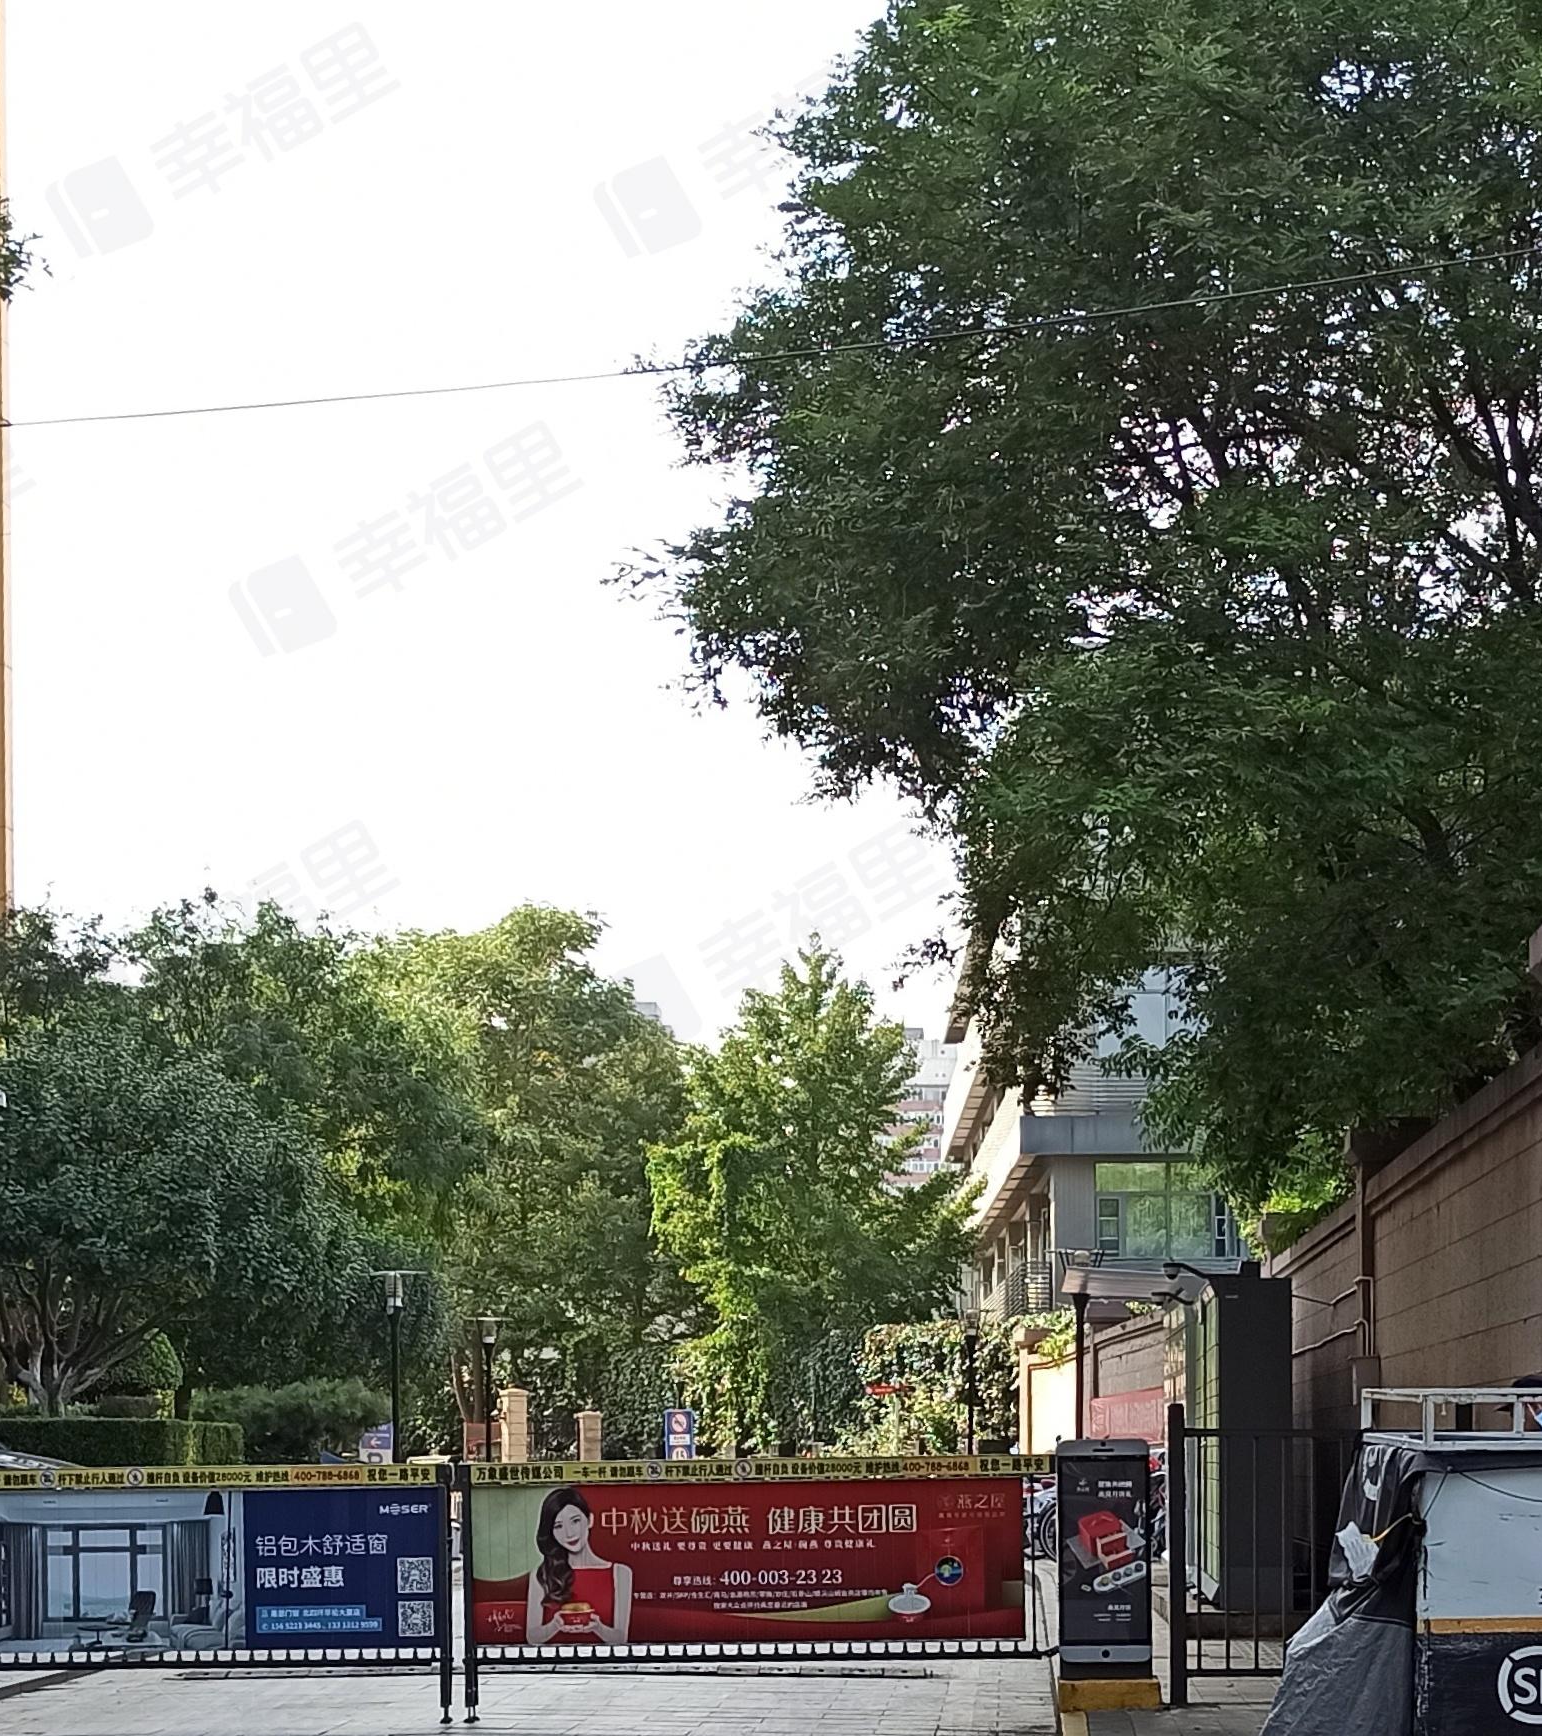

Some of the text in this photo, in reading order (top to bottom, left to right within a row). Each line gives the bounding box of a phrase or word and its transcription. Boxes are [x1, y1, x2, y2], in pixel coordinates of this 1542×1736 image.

[367, 1467, 430, 1481] 祝您一路平安
[979, 1459, 1045, 1472] 祝您一路平安
[379, 1504, 429, 1516] MOSER
[601, 1504, 917, 1536] 中秋送碗燕 健康共团圆
[255, 1534, 388, 1557] 铝包木舒适窗
[256, 1566, 345, 1589] 限时盛惠
